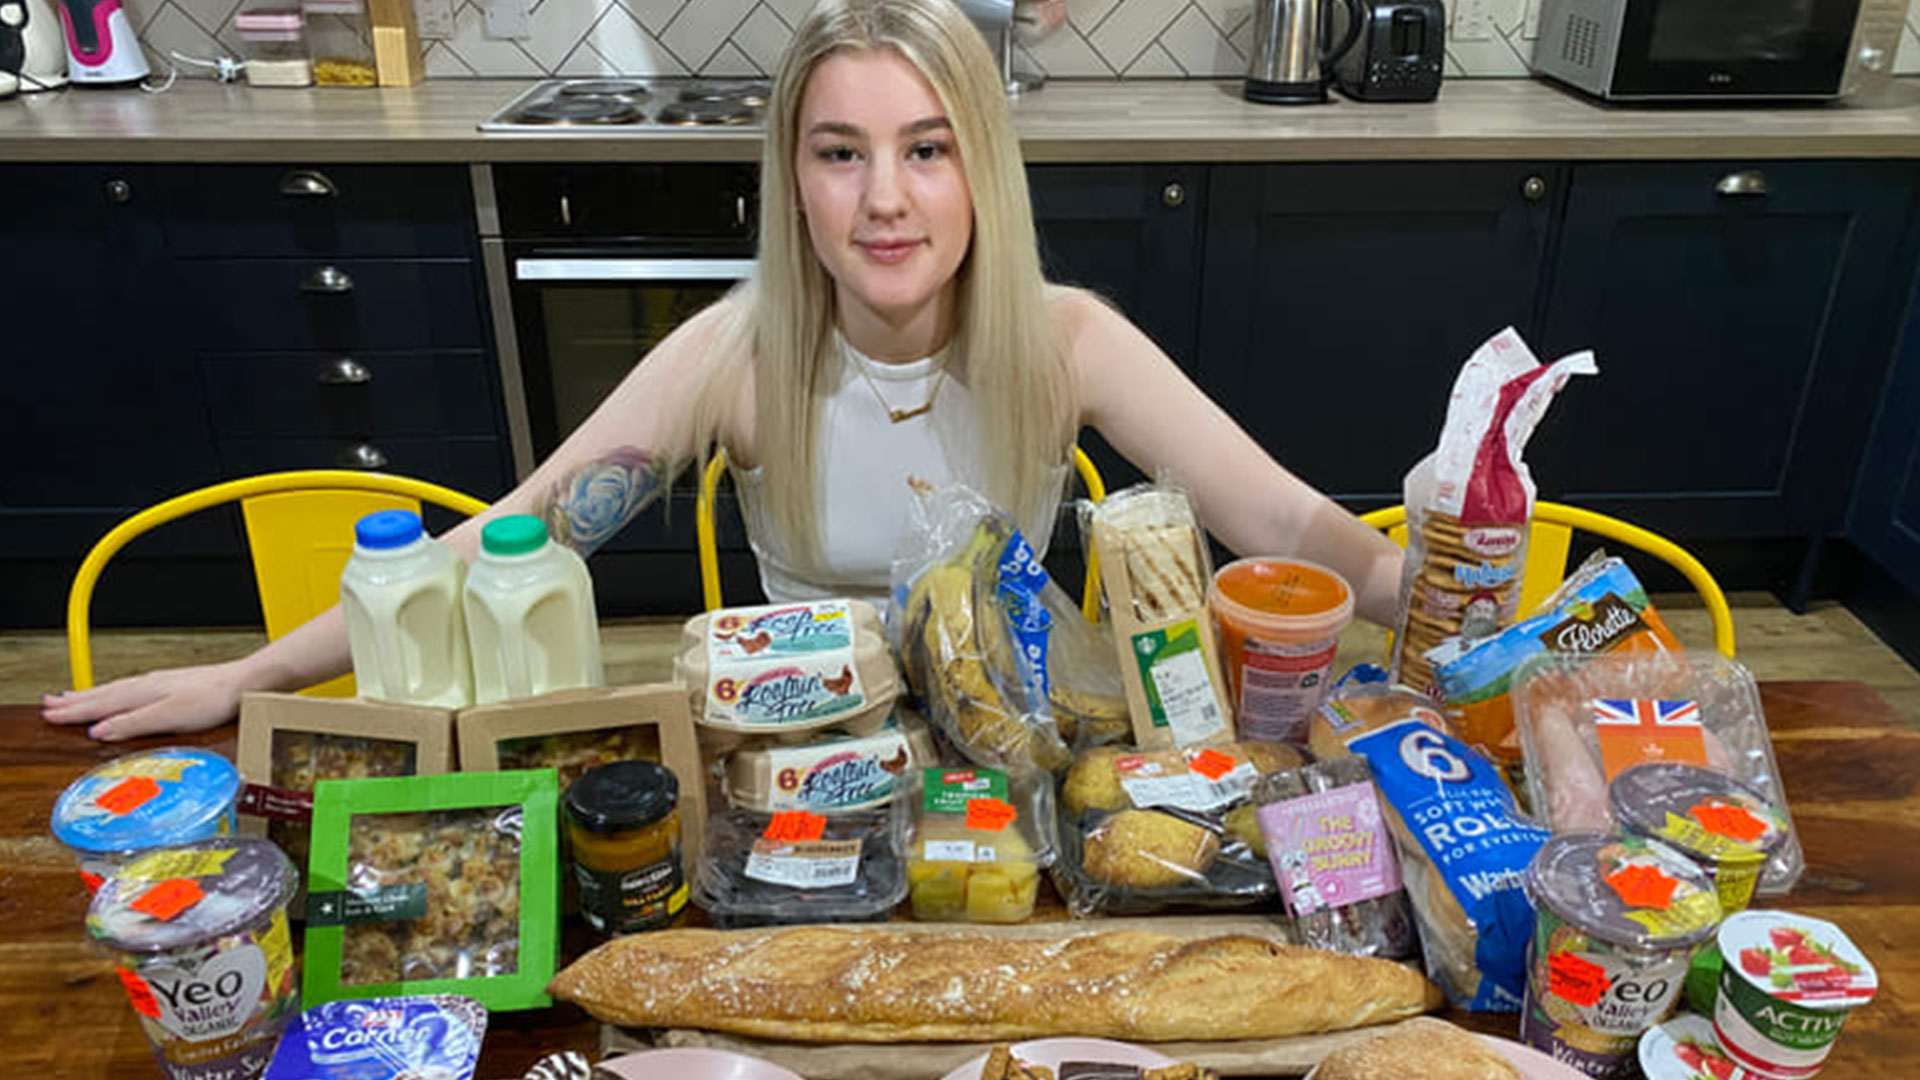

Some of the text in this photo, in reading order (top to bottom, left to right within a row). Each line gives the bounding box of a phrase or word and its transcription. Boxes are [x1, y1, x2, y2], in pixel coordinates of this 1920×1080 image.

[1557, 606, 1637, 652] Florette
[715, 678, 737, 701] 6
[1400, 730, 1472, 782] 6
[777, 767, 799, 791] 6
[1413, 798, 1466, 825] SOFT
[322, 1021, 431, 1050] Corner
